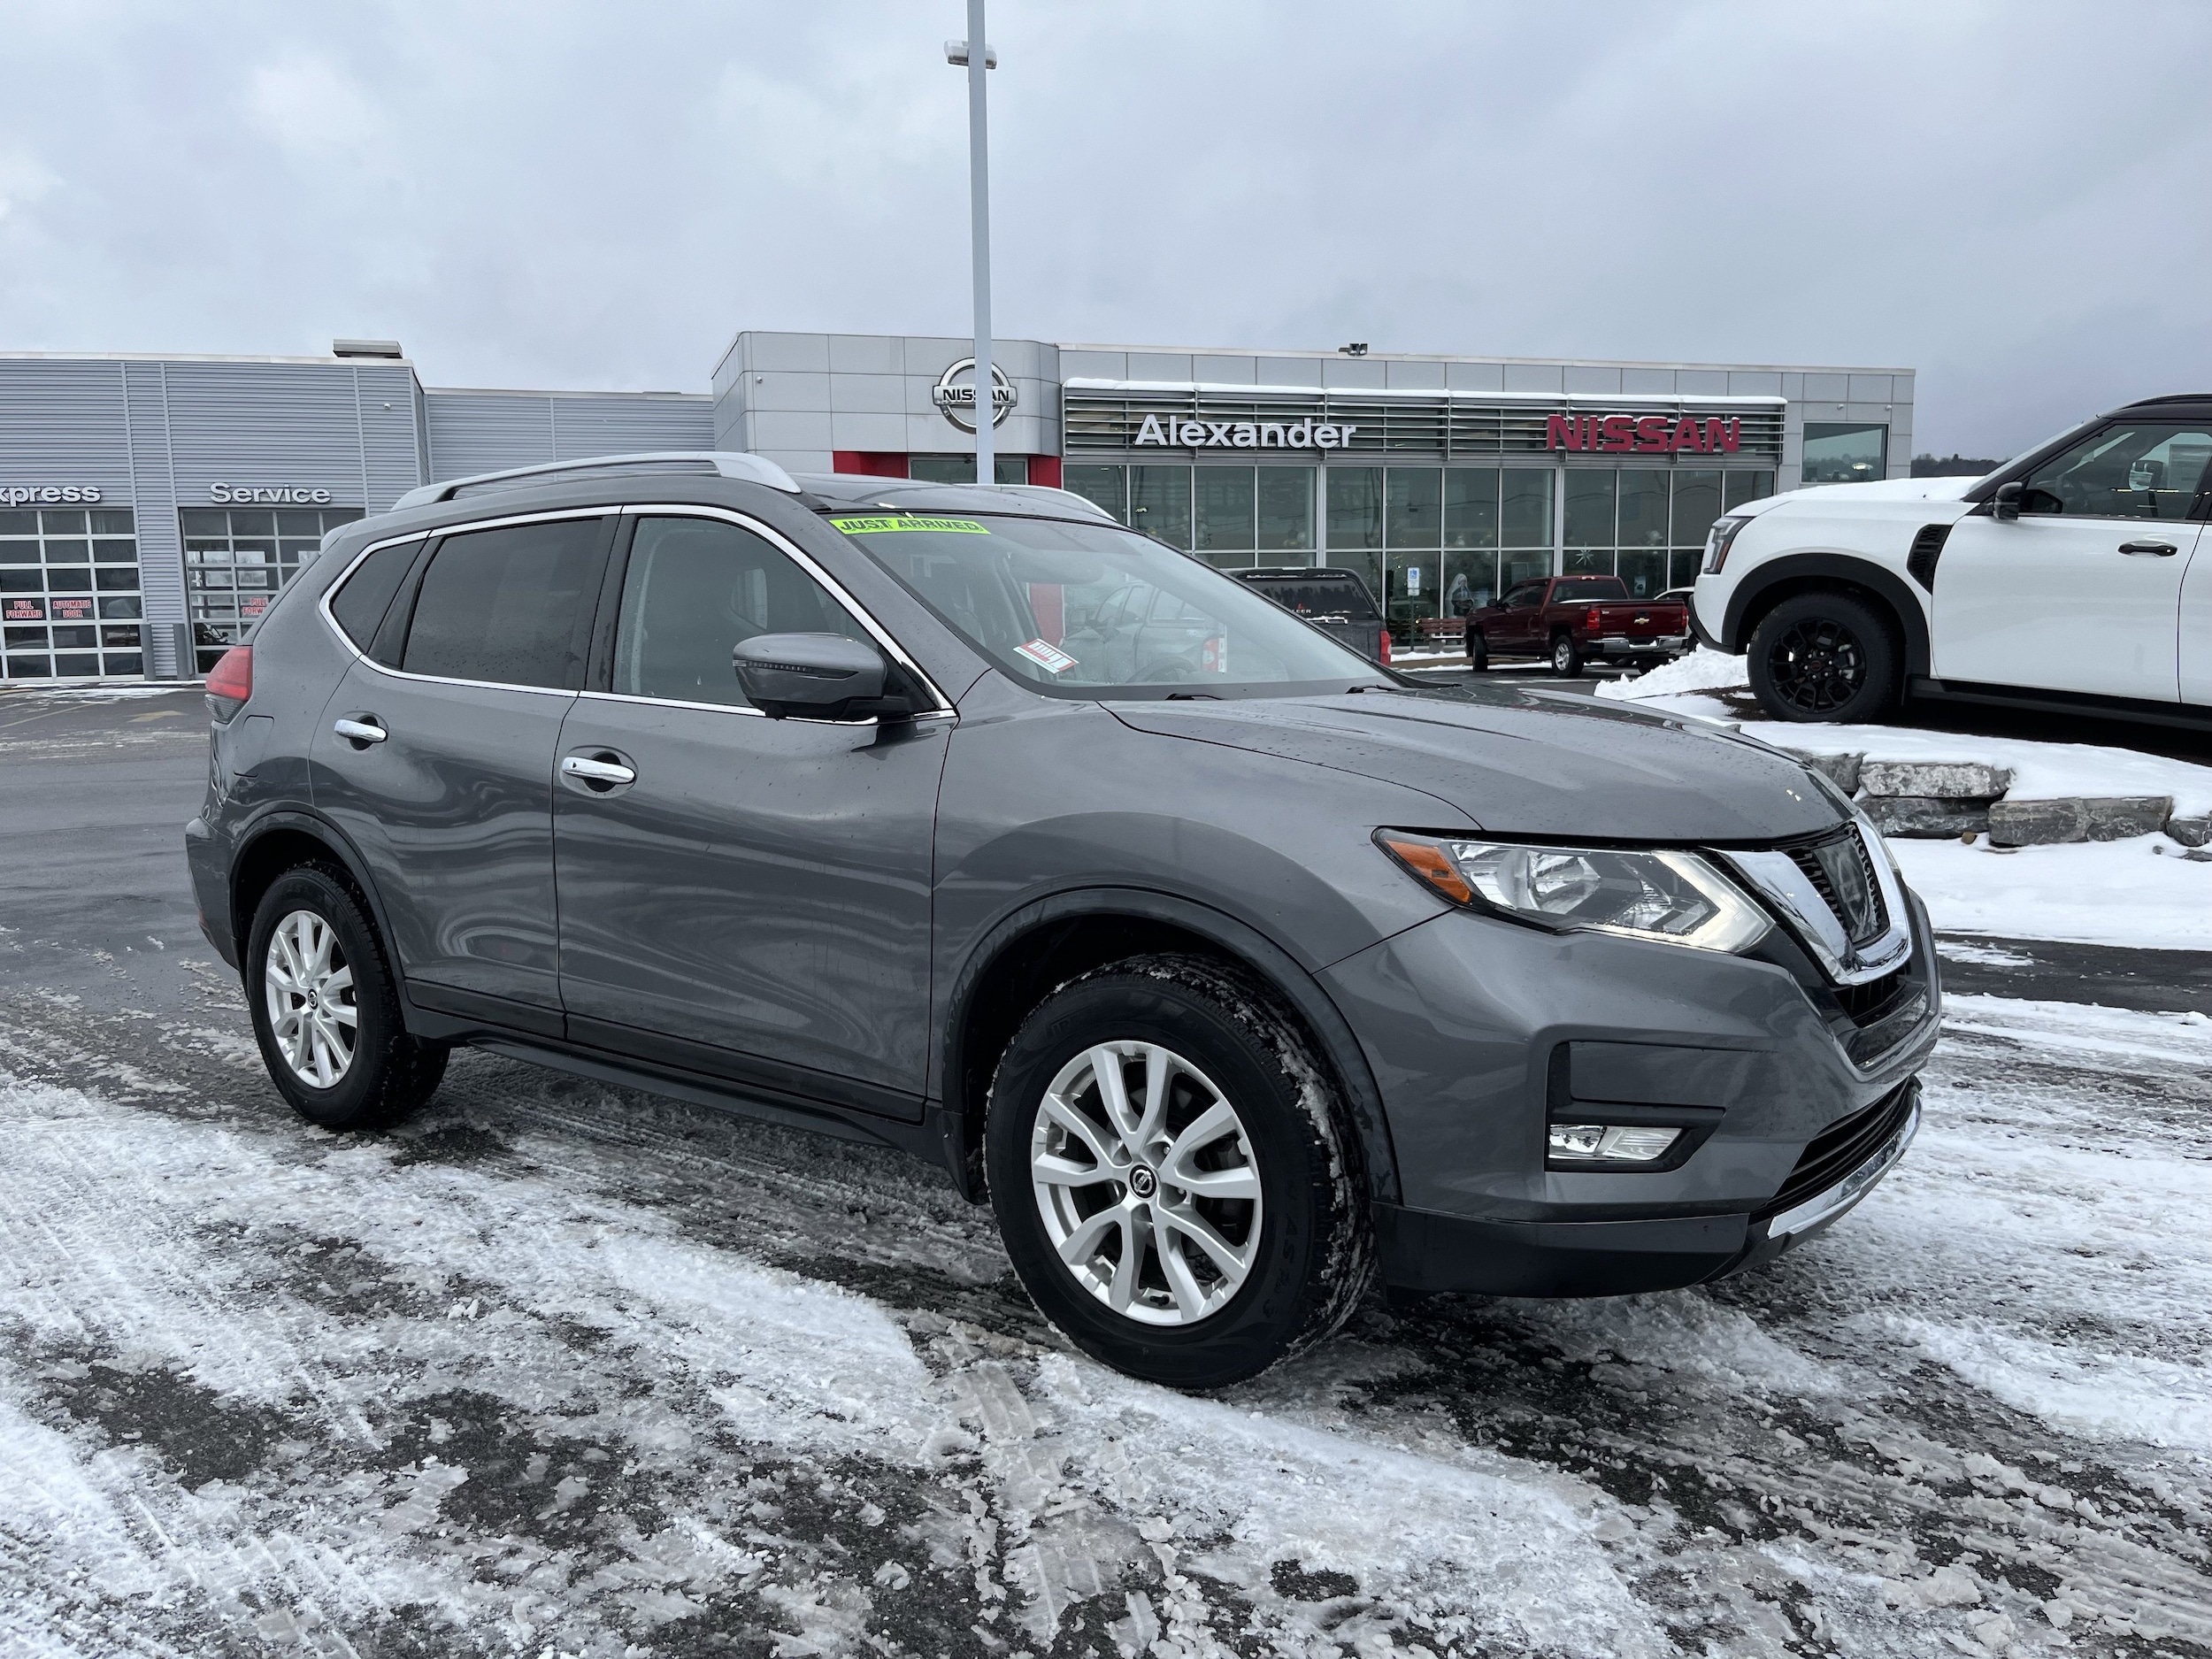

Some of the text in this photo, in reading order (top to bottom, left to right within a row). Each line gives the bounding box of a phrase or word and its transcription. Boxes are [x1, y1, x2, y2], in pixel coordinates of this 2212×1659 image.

[942, 388, 1010, 402] NISN
[1133, 413, 1356, 449] Alexander
[1547, 413, 1740, 453] NISSAN
[210, 482, 332, 504] Service
[841, 518, 981, 532] JUST ARRIVED
[14, 600, 34, 609] PULL
[53, 600, 91, 609] AUTOMATIC
[6, 610, 42, 618] FORWARD
